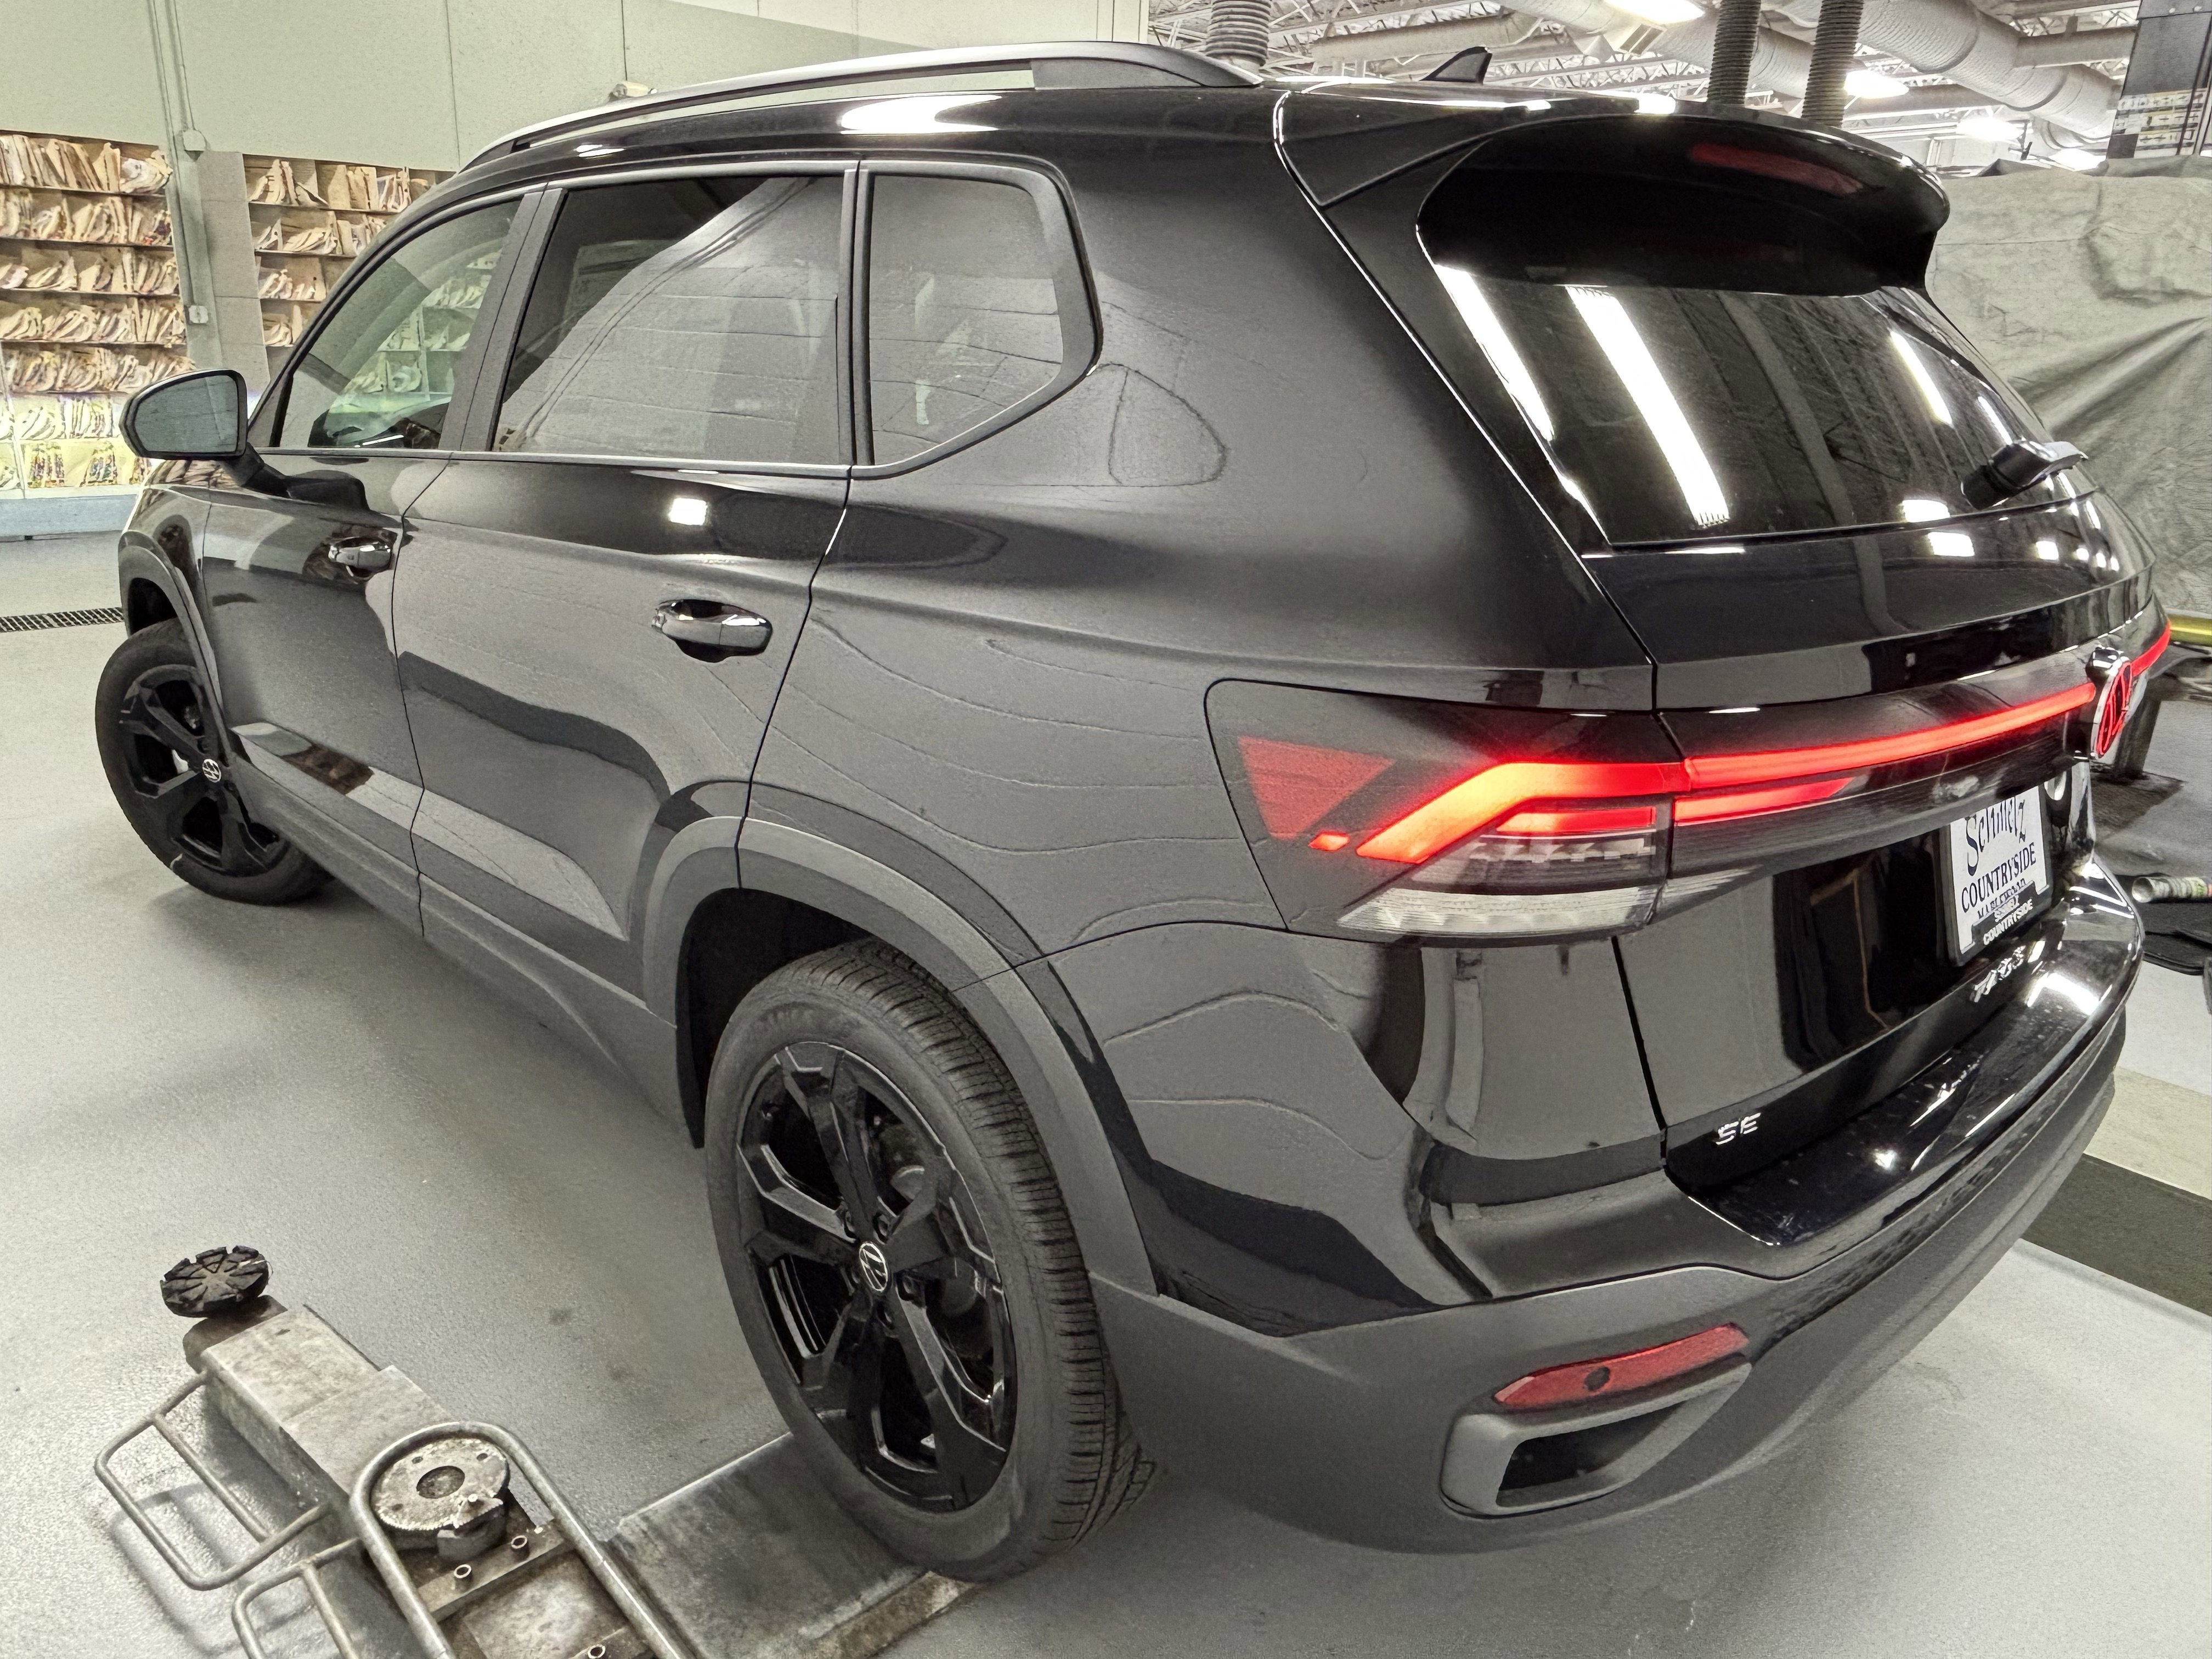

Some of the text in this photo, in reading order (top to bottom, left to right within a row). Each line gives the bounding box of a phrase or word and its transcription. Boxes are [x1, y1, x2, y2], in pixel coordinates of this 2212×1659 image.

[1961, 842, 2036, 913] COUNTRYSIDE
[1983, 898, 2033, 945] COUNTRYSIDE
[1716, 1112, 1761, 1145] SE
